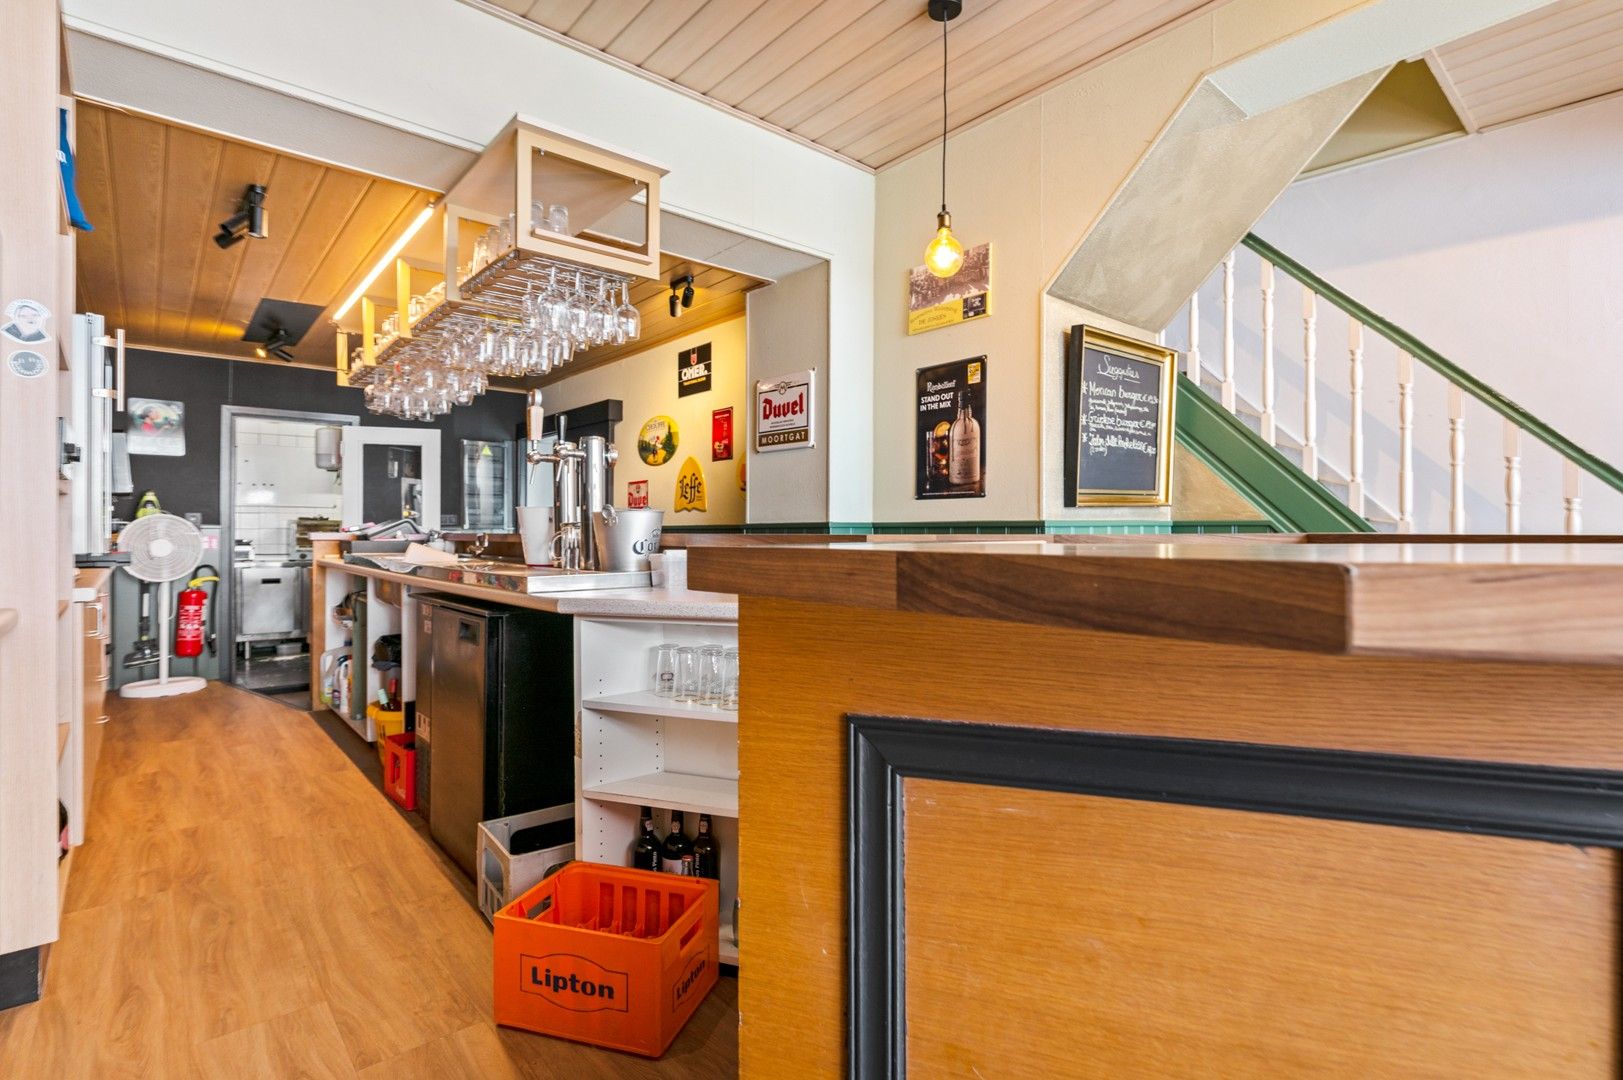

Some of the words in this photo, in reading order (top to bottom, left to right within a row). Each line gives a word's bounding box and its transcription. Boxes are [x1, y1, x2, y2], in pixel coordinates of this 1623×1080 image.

[762, 391, 804, 420] Duvel
[919, 404, 927, 412] IN
[927, 402, 939, 411] THE
[939, 400, 952, 409] MIX
[920, 394, 940, 404] STAND
[940, 391, 954, 401] OUT
[761, 431, 805, 444] MOORTGAT
[679, 472, 702, 505] Leffe
[628, 492, 648, 508] Duvel
[531, 966, 614, 1000] Lipton
[676, 959, 706, 1001] Lipton
